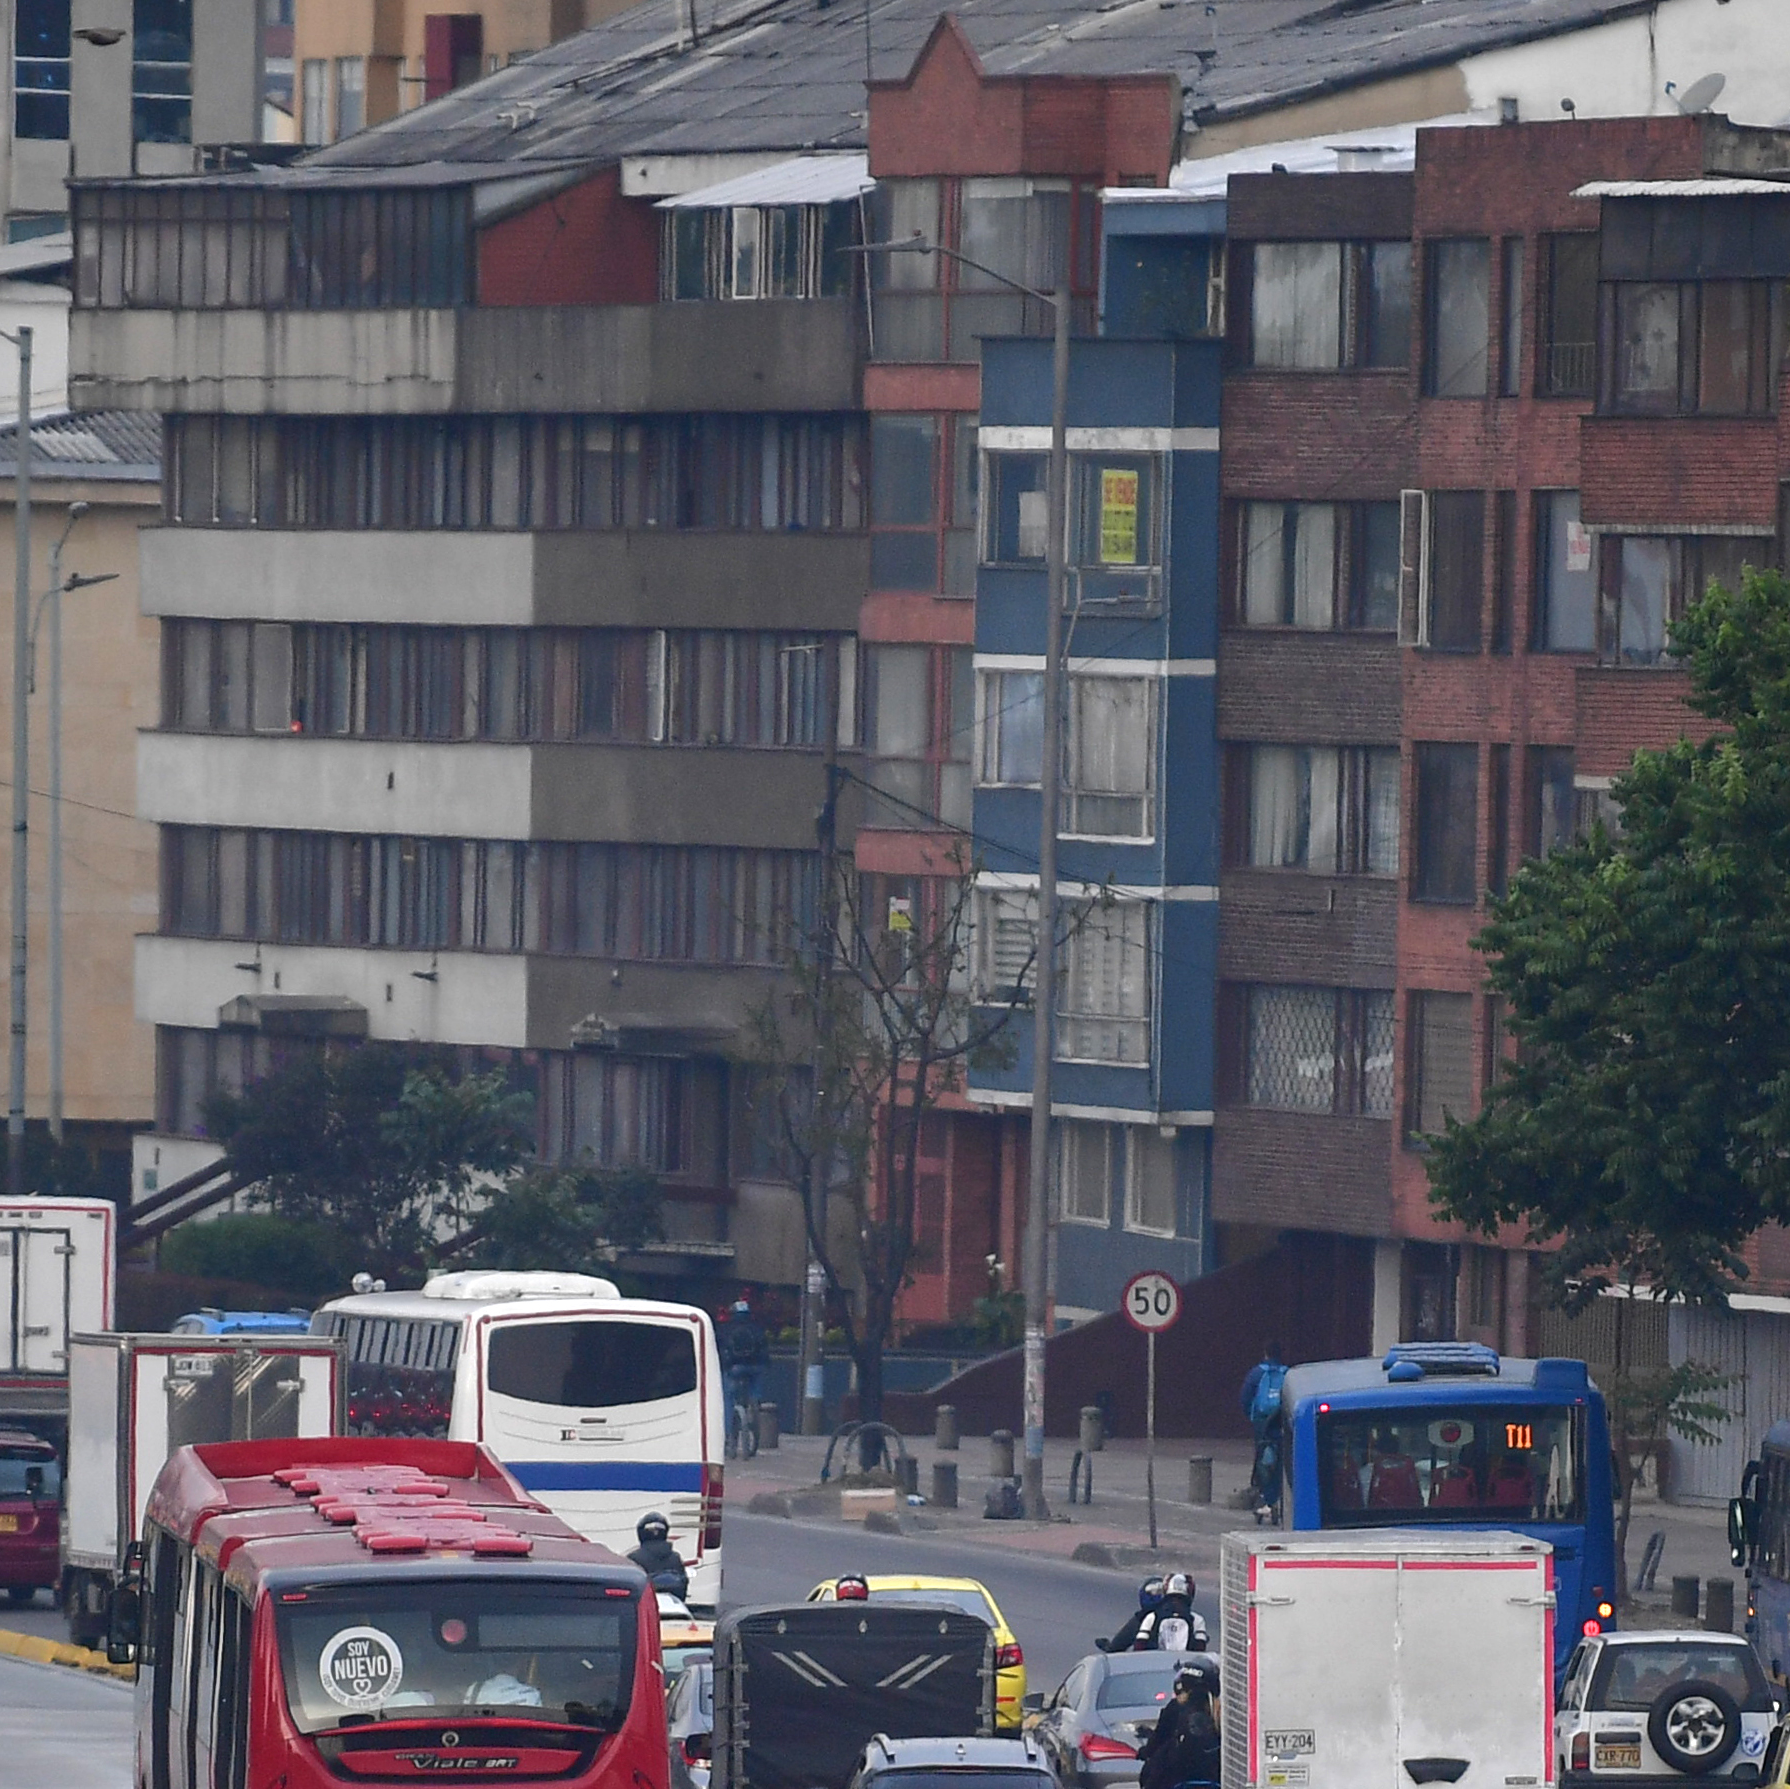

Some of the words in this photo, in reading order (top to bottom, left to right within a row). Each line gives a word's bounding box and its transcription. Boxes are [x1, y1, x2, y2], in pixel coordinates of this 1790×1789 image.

[1134, 1287, 1172, 1316] 50
[1505, 1423, 1533, 1449] T11
[347, 1641, 370, 1657] SOY
[333, 1655, 388, 1680] NUEVO
